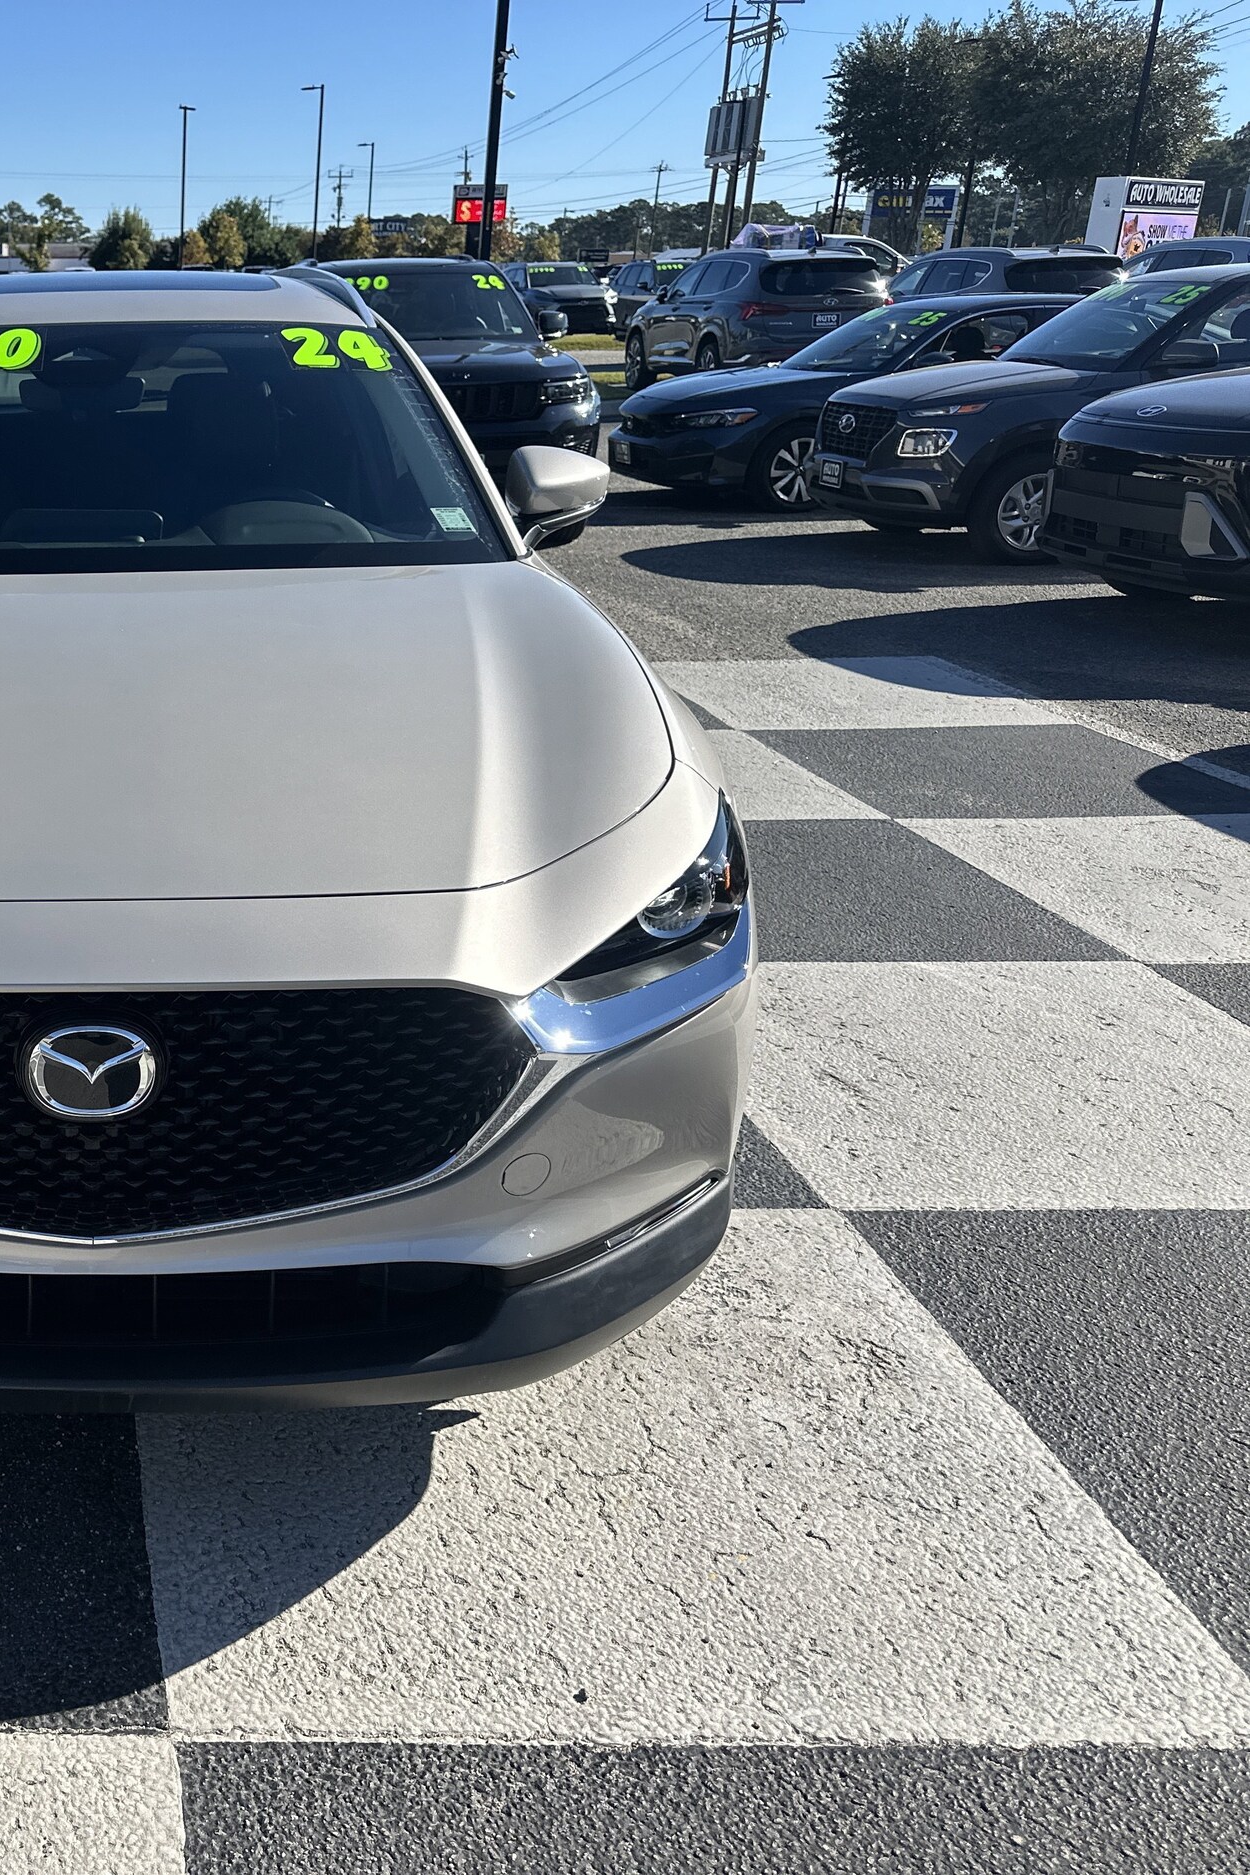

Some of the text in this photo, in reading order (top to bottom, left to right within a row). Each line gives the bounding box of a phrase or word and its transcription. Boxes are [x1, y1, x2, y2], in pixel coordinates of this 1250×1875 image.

[1130, 183, 1202, 204] AUTO WHOLESALE
[386, 221, 407, 232] CITY
[1147, 224, 1168, 239] SHOW
[472, 274, 506, 290] 24
[1159, 285, 1212, 305] 25
[815, 314, 837, 323] AUTO
[907, 311, 948, 327] 25
[280, 327, 394, 372] 24
[823, 462, 840, 476] AUTO
